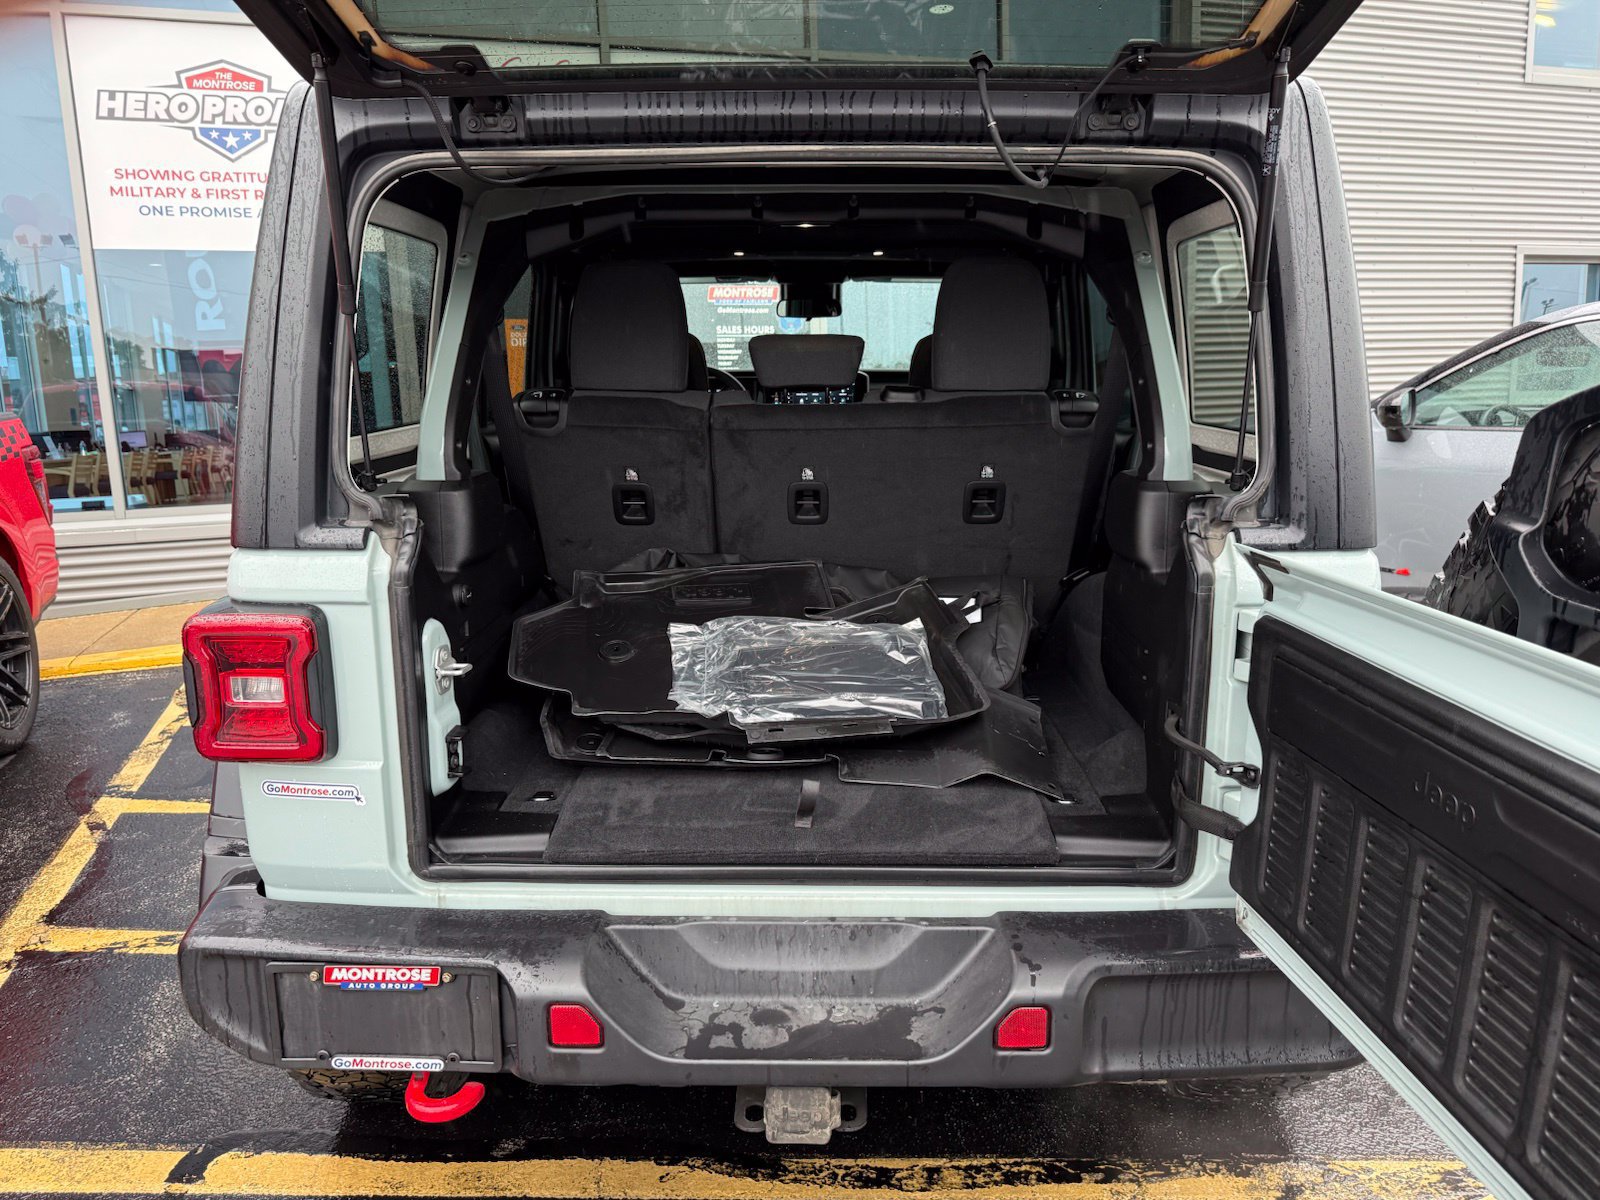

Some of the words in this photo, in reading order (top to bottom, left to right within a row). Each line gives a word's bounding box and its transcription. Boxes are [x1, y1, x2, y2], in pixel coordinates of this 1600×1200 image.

[215, 72, 232, 80] THE
[193, 79, 256, 91] MONTROSE
[96, 89, 199, 123] HERO
[114, 168, 195, 182] SHOWING
[110, 186, 187, 198] MILITARY
[191, 188, 202, 199] &
[206, 189, 250, 200] FIRST
[139, 204, 175, 217] ONE
[180, 206, 252, 218] PROMISE
[185, 250, 226, 331] RO
[713, 287, 774, 298] MONTROSE
[716, 325, 742, 334] SALES
[743, 325, 775, 334] HOURS
[266, 784, 354, 797] GoMontrose.com
[331, 968, 432, 981] MONTROSE
[334, 1058, 442, 1070] GoMontrose.com
[775, 1106, 823, 1128] Jeep
